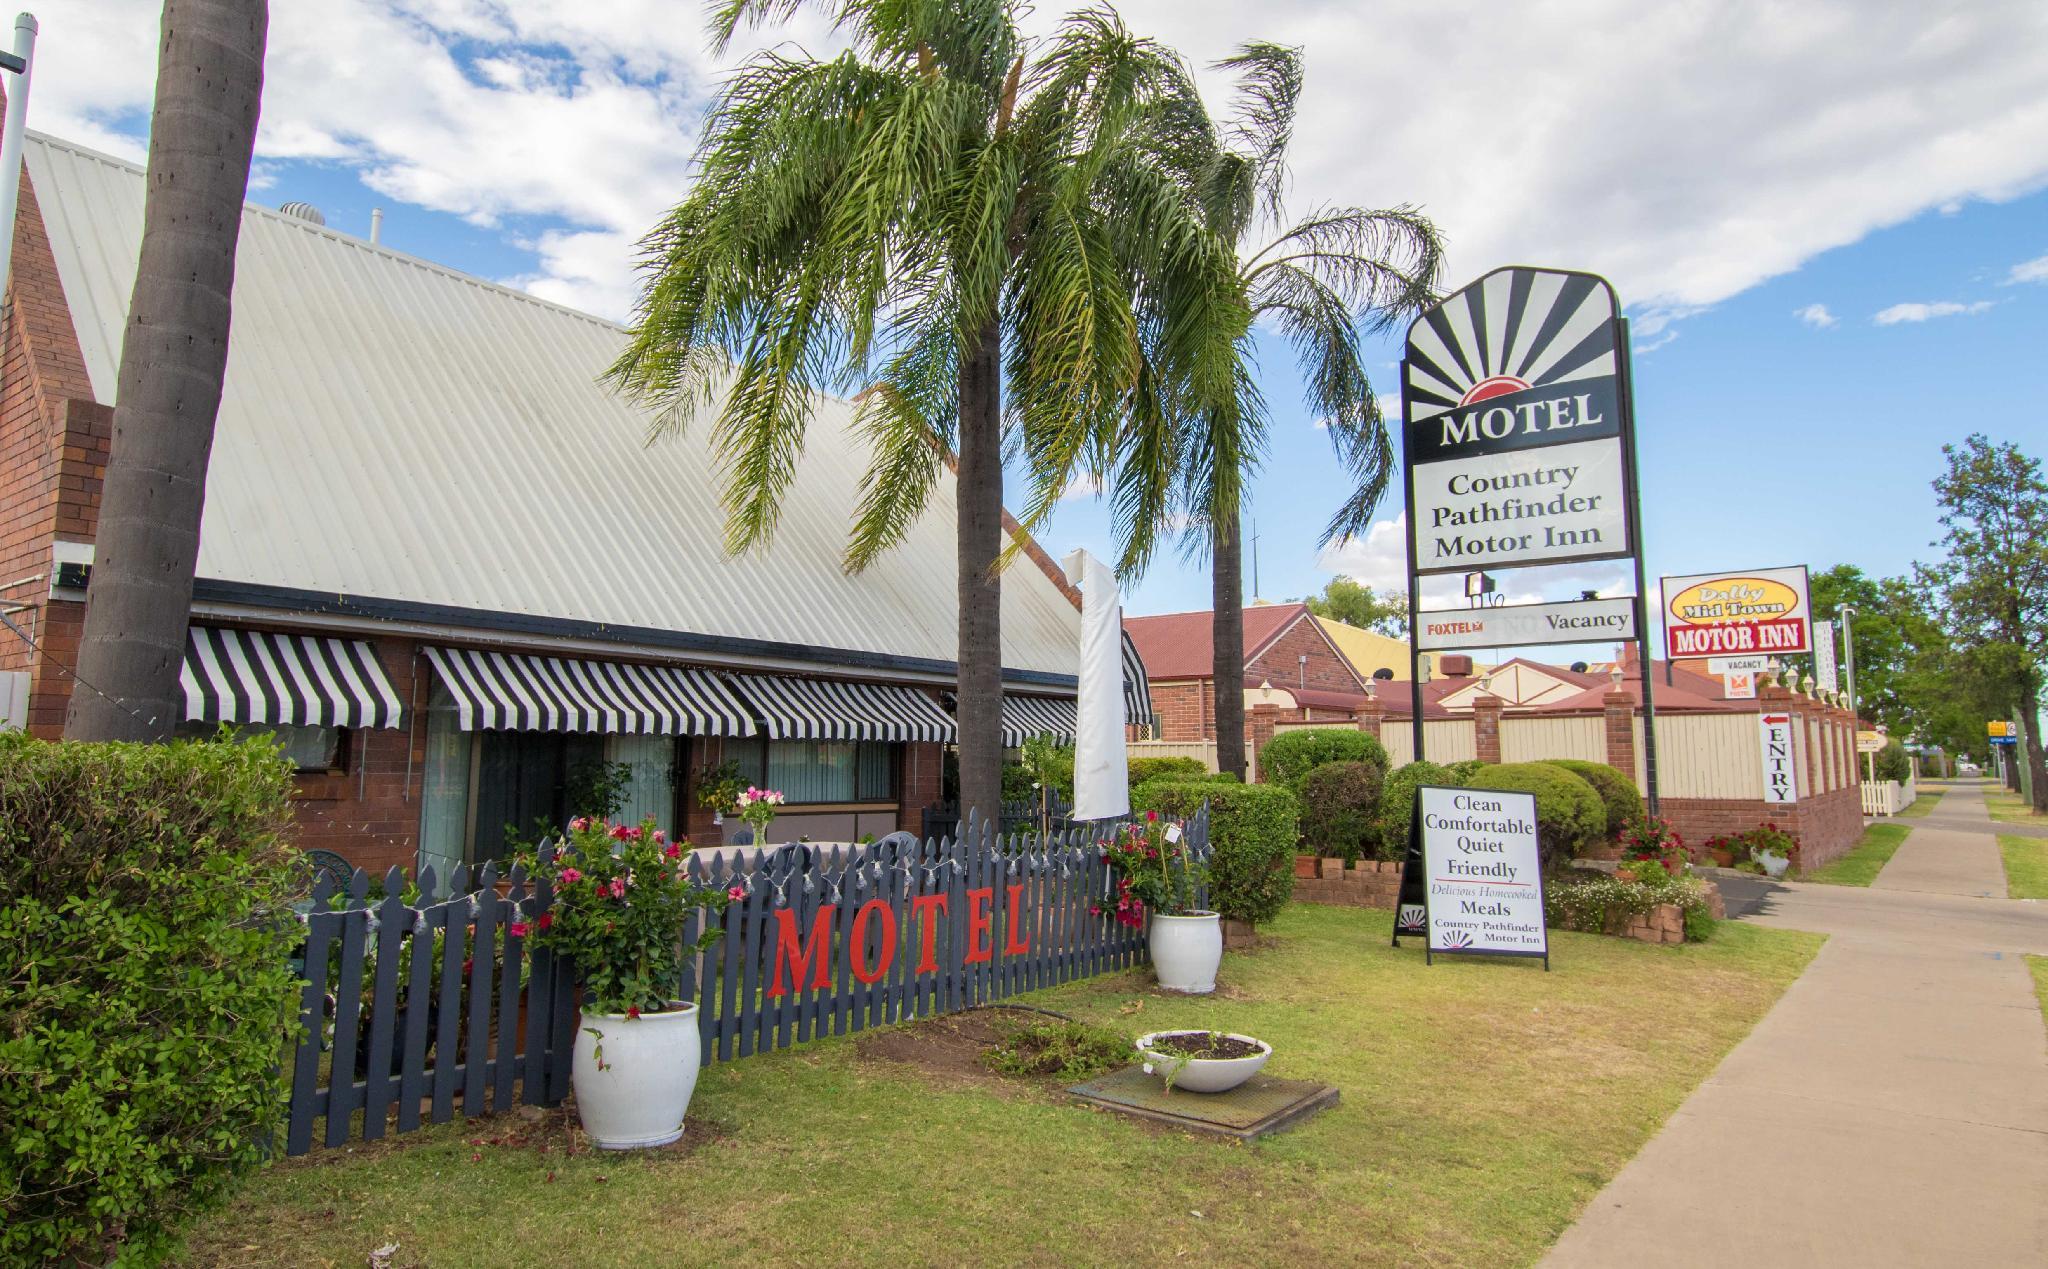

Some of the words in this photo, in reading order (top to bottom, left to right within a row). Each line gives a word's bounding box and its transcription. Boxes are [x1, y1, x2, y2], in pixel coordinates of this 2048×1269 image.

[1440, 393, 1603, 447] MOTEL
[1448, 464, 1579, 497] Country
[1432, 494, 1602, 528] Pathfinder
[1435, 533, 1532, 558] Motor
[1544, 526, 1602, 548] Inn
[1699, 584, 1764, 602] Dalby
[1683, 604, 1723, 619] Mid
[1726, 602, 1785, 616] Town
[1427, 622, 1472, 636] FOXTEL
[1545, 613, 1629, 632] Vacancy
[1676, 626, 1754, 653] MOTOR
[1758, 623, 1798, 648] INN
[1728, 660, 1762, 669] VACANCY
[1768, 728, 1790, 801] ENTRY
[1453, 795, 1502, 812] Clean
[1425, 813, 1534, 835] Comfortable
[1457, 836, 1505, 854] Quiet
[1447, 859, 1518, 883] Friendly
[1431, 883, 1476, 897] Delicious
[1479, 886, 1538, 900] Homecooked
[1461, 900, 1511, 917] Meals
[1435, 918, 1480, 932] Country
[1482, 921, 1540, 933] Pathfinder
[767, 884, 1032, 999] MOTEL
[1484, 933, 1519, 943] Motor
[1521, 934, 1540, 944] Inn
